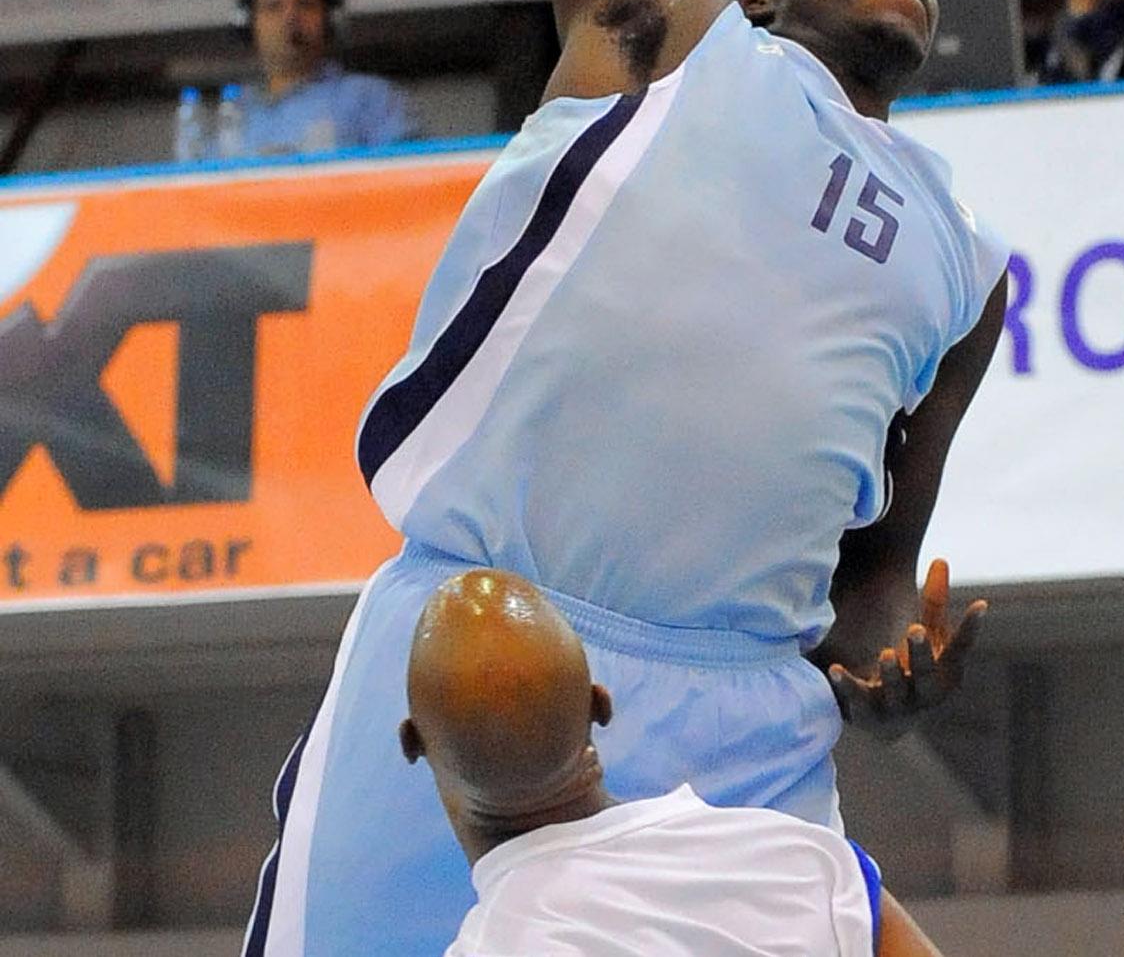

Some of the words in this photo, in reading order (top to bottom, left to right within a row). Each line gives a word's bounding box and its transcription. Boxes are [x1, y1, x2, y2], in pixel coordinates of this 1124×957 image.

[811, 152, 905, 265] 15
[58, 548, 97, 586] a
[131, 538, 253, 585] car
